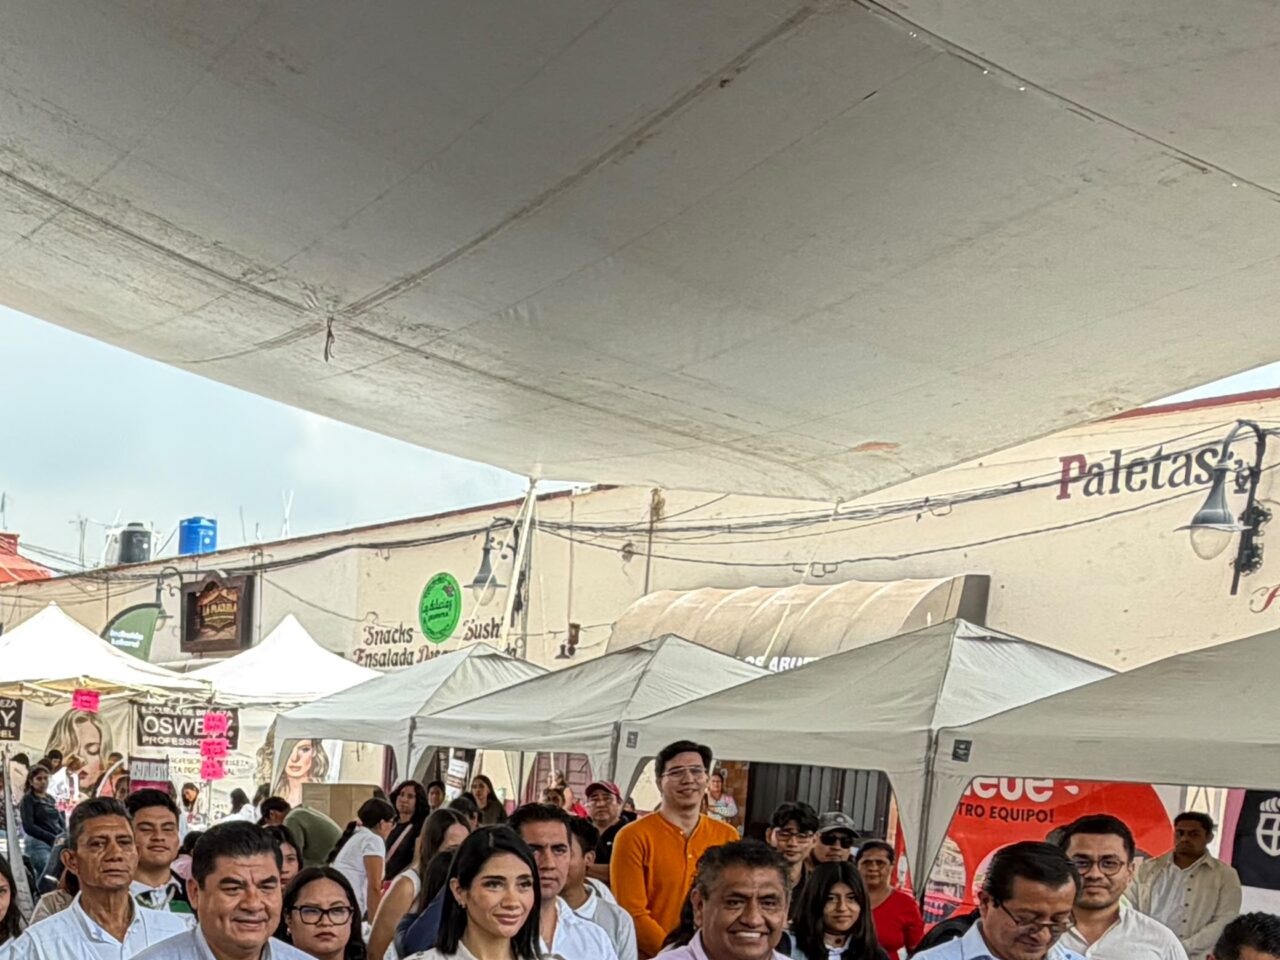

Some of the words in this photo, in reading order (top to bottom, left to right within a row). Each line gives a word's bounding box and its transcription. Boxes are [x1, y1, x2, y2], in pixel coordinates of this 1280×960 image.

[1056, 445, 1219, 500] Paletas
[363, 622, 414, 645] Snacks
[353, 646, 415, 668] Ensalada
[989, 805, 1055, 823] EQUIPO!
